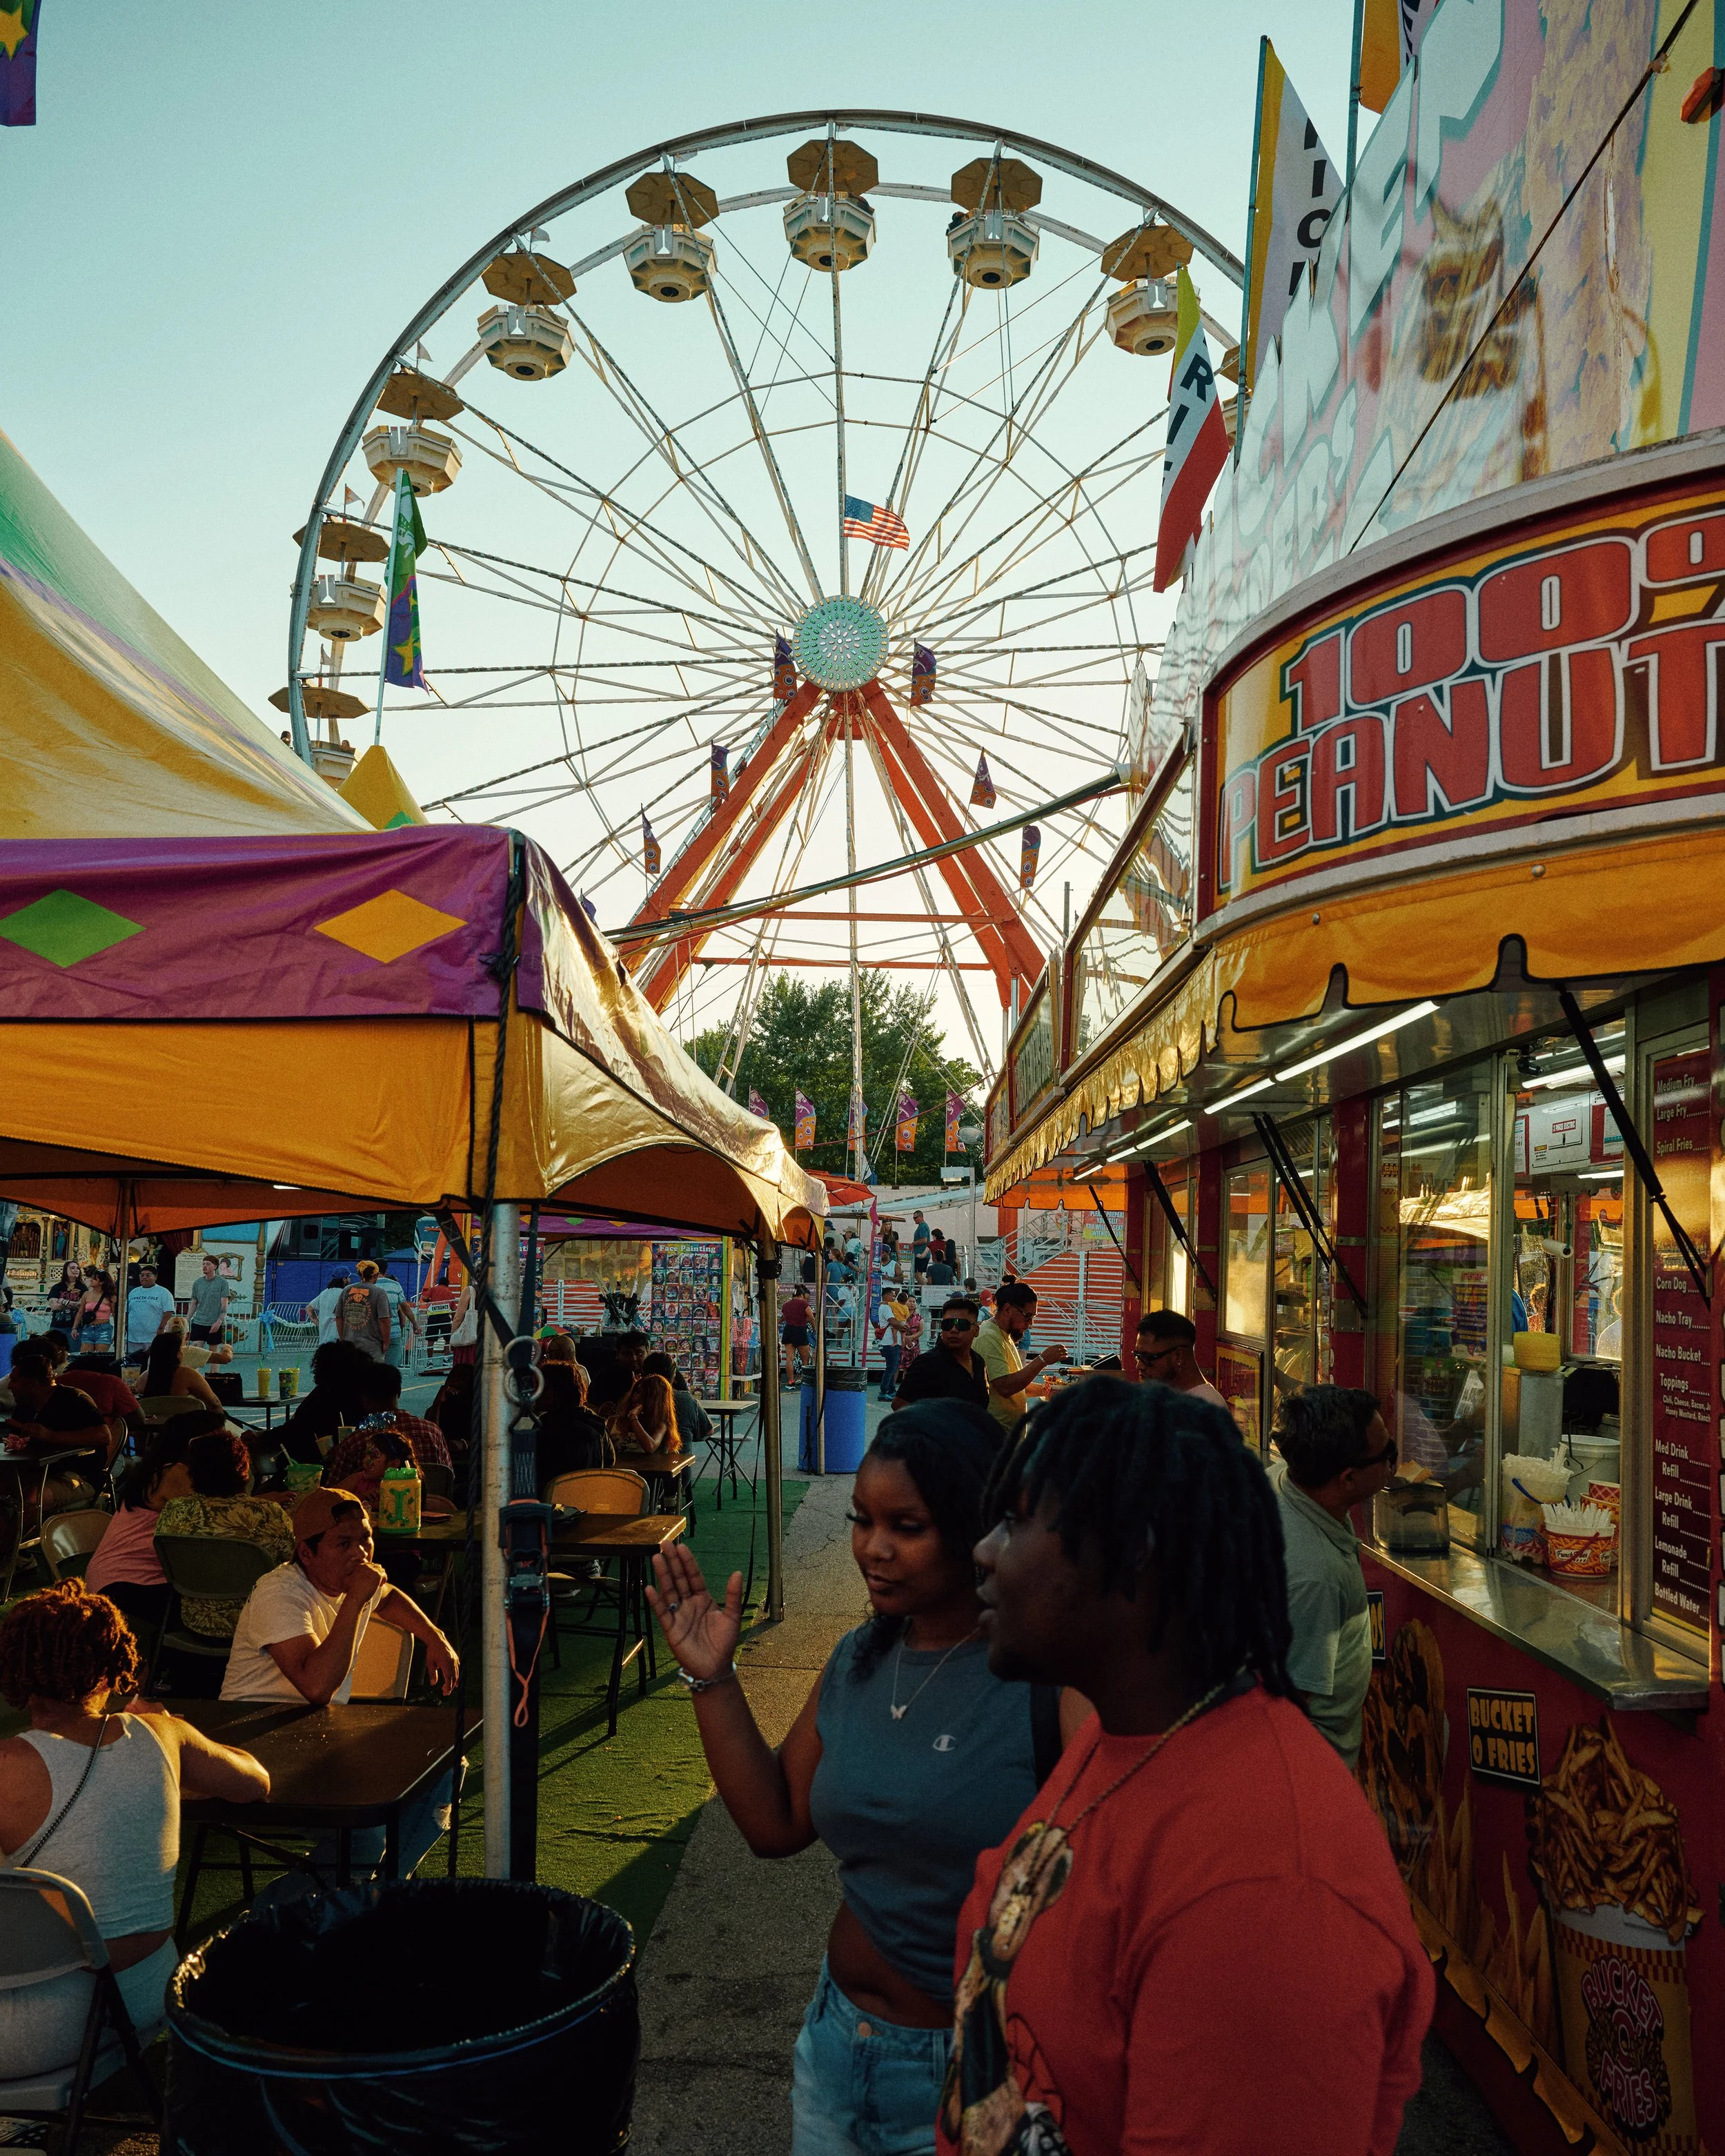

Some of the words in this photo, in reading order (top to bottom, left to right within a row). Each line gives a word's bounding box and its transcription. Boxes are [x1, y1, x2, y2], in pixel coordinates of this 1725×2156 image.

[1657, 1077, 1682, 1093] Medium
[1684, 1074, 1695, 1088] Fry
[1657, 1108, 1675, 1122] Large
[1676, 1103, 1687, 1118] Fry
[1657, 1138, 1675, 1156] Spiral
[1677, 1137, 1693, 1152] Fries
[680, 1245, 716, 1254] Painting
[1657, 1276, 1672, 1290] Corn
[1673, 1276, 1687, 1294] Dog
[1656, 1310, 1676, 1325] Nacho
[1678, 1311, 1693, 1329] Tray
[1656, 1343, 1675, 1359] Nacho
[1677, 1346, 1702, 1362] Bucket
[1659, 1372, 1689, 1393] Toppings
[1663, 1394, 1674, 1405] Chili,
[1674, 1396, 1690, 1409] Cheese,
[1691, 1398, 1706, 1411] Bacon,
[1665, 1405, 1678, 1418] Honey
[1679, 1408, 1697, 1422] Mustard,
[1697, 1412, 1711, 1423] Ranch
[1655, 1438, 1669, 1455] Med
[1670, 1443, 1689, 1460] Drink
[1662, 1461, 1679, 1478] Refill
[1655, 1485, 1673, 1506] Large
[1674, 1492, 1693, 1510] Drink
[1662, 1511, 1679, 1529] Refill
[1557, 1550, 1573, 1559] French
[1655, 1535, 1687, 1559] Lemonade
[1662, 1559, 1679, 1578] Refill
[1655, 1582, 1678, 1605] Bottled
[1679, 1592, 1700, 1614] Water
[1469, 1697, 1534, 1734] BUCKET
[1472, 1734, 1483, 1765] O
[1487, 1737, 1535, 1774] FRIES
[1582, 1958, 1663, 2034] BUCKET
[1600, 2050, 1657, 2127] FRIES
